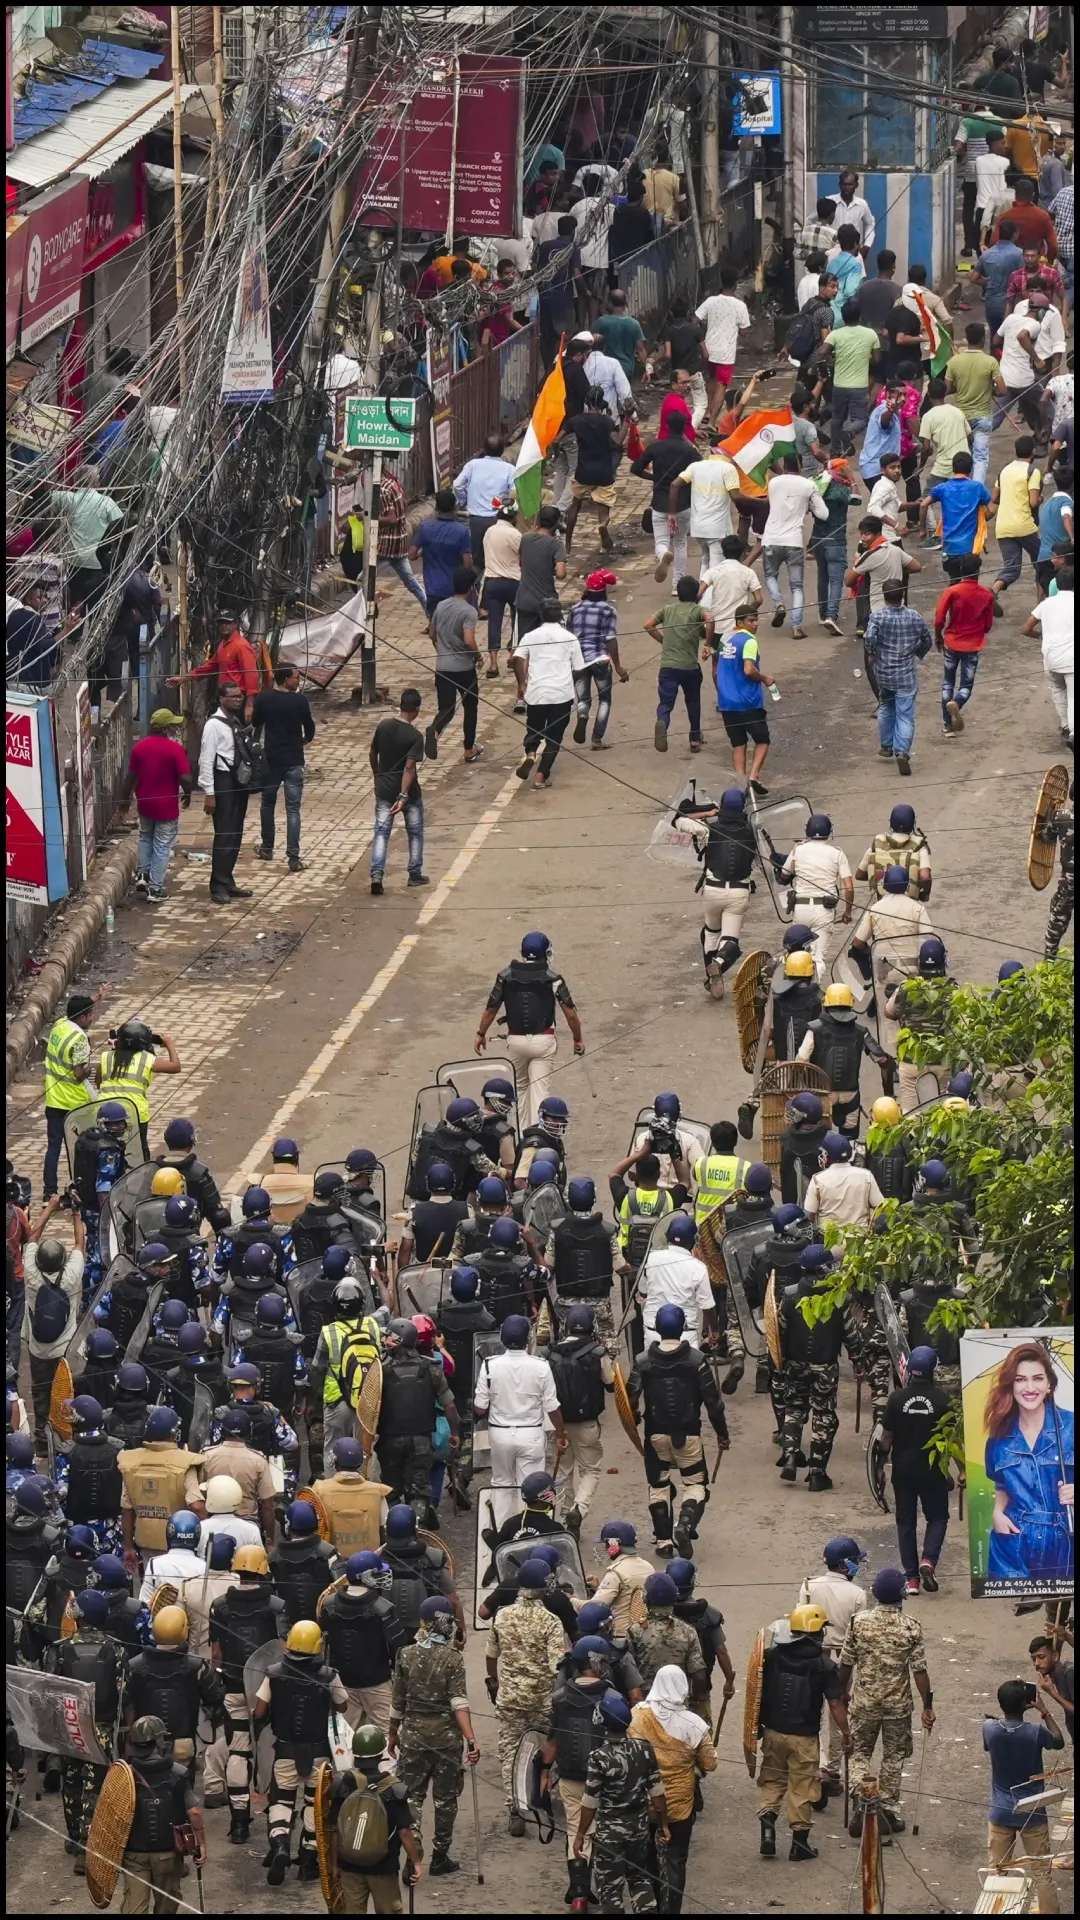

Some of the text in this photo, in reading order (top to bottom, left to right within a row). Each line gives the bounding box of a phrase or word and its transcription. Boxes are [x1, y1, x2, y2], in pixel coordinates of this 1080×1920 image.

[421, 84, 451, 92] HANDRA
[460, 86, 484, 95] AREKH
[44, 218, 83, 266] BODYCARE
[351, 405, 379, 417] হাওড়া
[357, 420, 398, 431] Howra
[358, 433, 400, 444] Maidan
[6, 747, 31, 760] AZAR
[708, 1168, 730, 1182] MEDIA
[638, 1202, 656, 1212] MEDI
